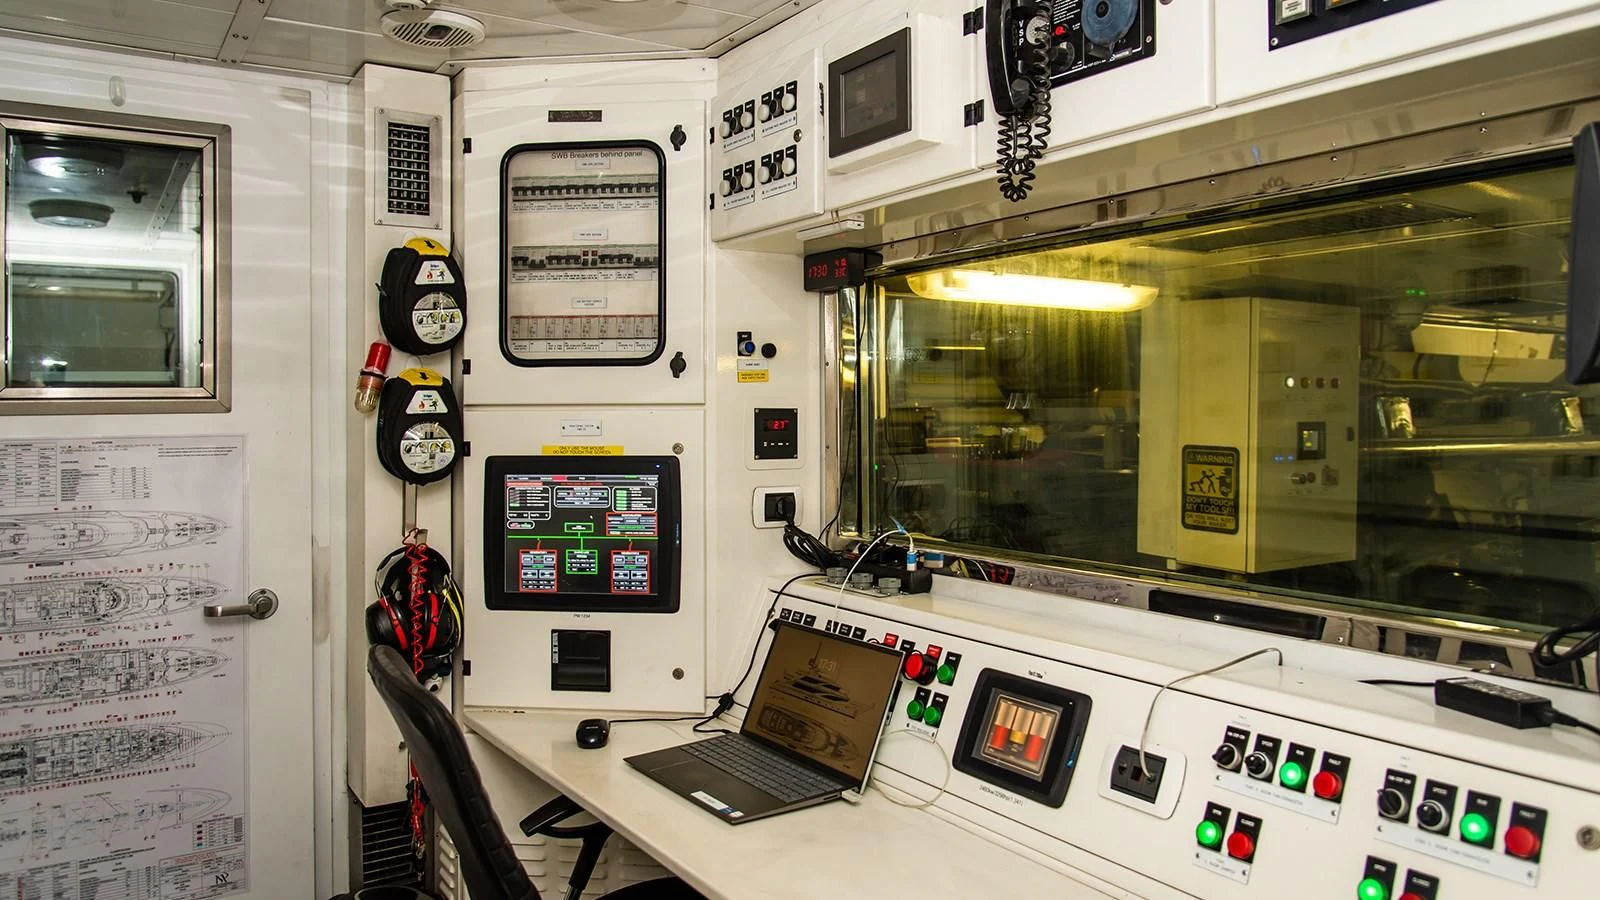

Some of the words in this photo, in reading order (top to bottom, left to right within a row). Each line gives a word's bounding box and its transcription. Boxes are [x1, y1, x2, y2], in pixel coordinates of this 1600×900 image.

[552, 152, 569, 160] SWB
[624, 151, 643, 159] panel
[1196, 455, 1232, 464] WARNING
[1210, 497, 1234, 506] TOUCH
[1186, 503, 1196, 511] MY
